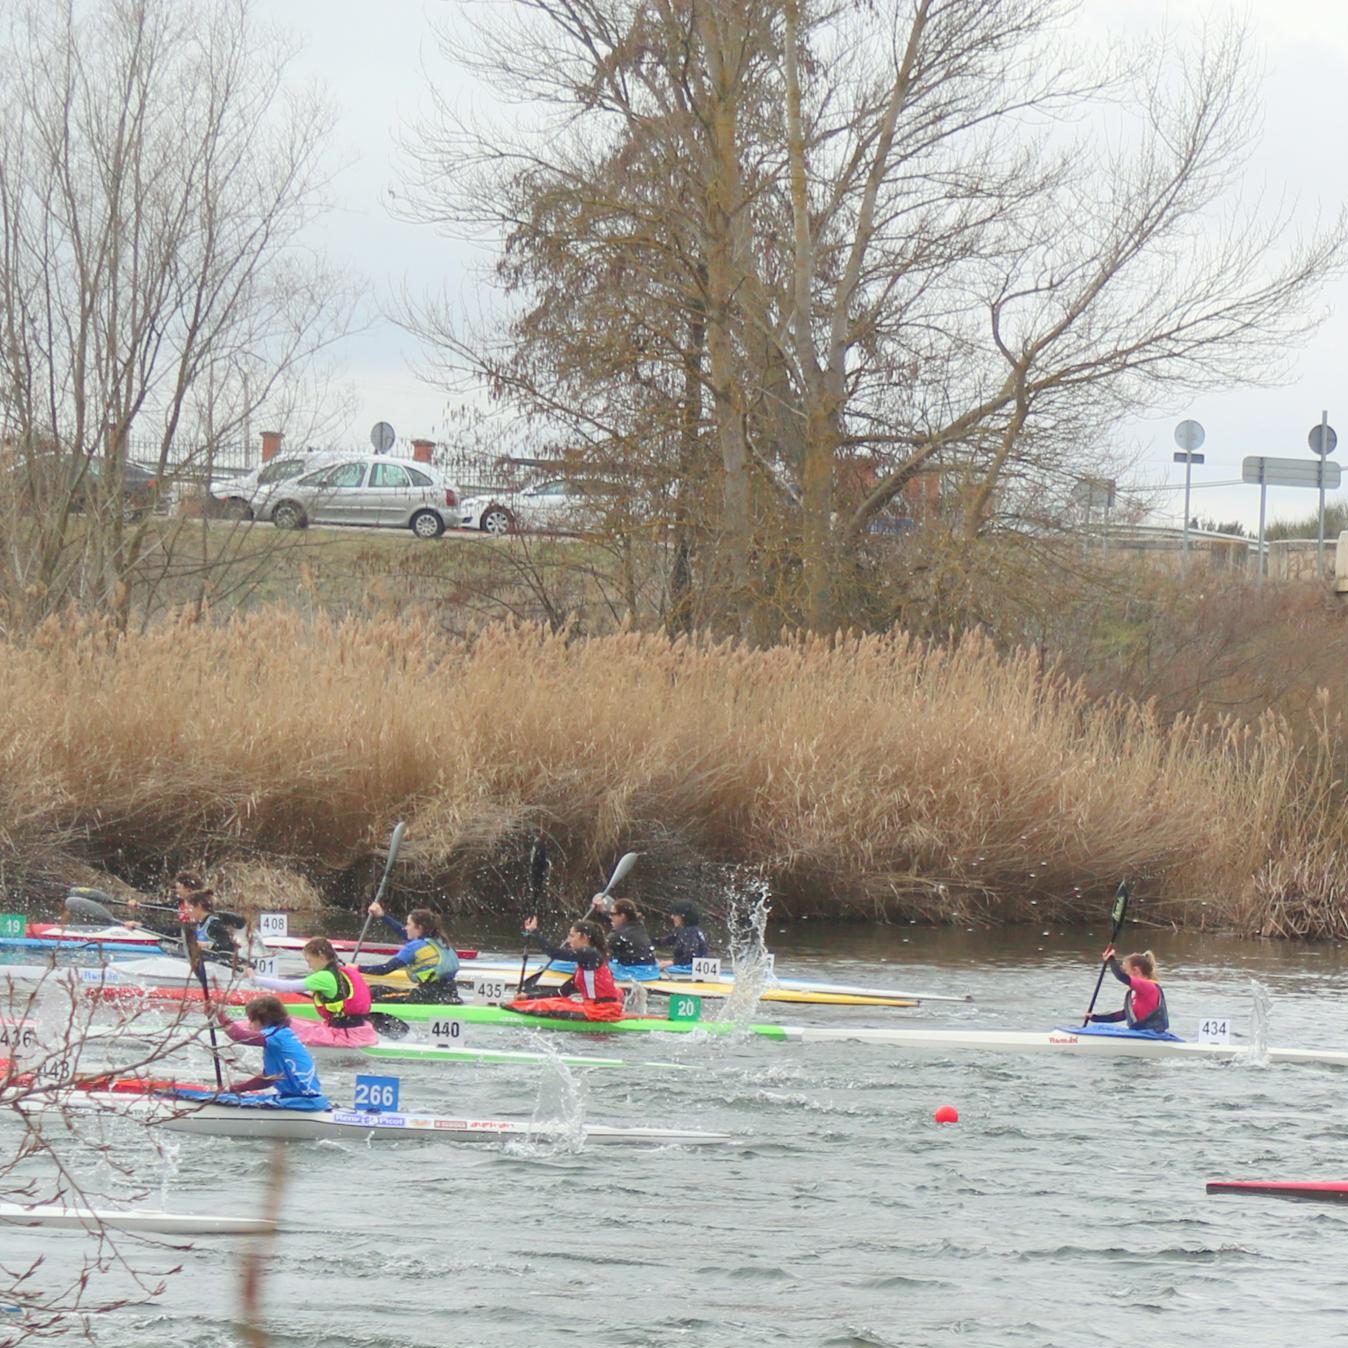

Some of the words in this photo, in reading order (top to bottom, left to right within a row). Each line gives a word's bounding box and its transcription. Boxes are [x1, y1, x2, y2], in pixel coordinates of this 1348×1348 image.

[6, 919, 20, 933] 19
[263, 916, 285, 930] 408
[695, 962, 718, 976] 404
[477, 983, 502, 998] 435
[677, 1001, 694, 1016] 20
[432, 1021, 460, 1038] 440
[1202, 1020, 1227, 1036] 434
[0, 1029, 32, 1048] 436
[355, 1084, 394, 1106] 266
